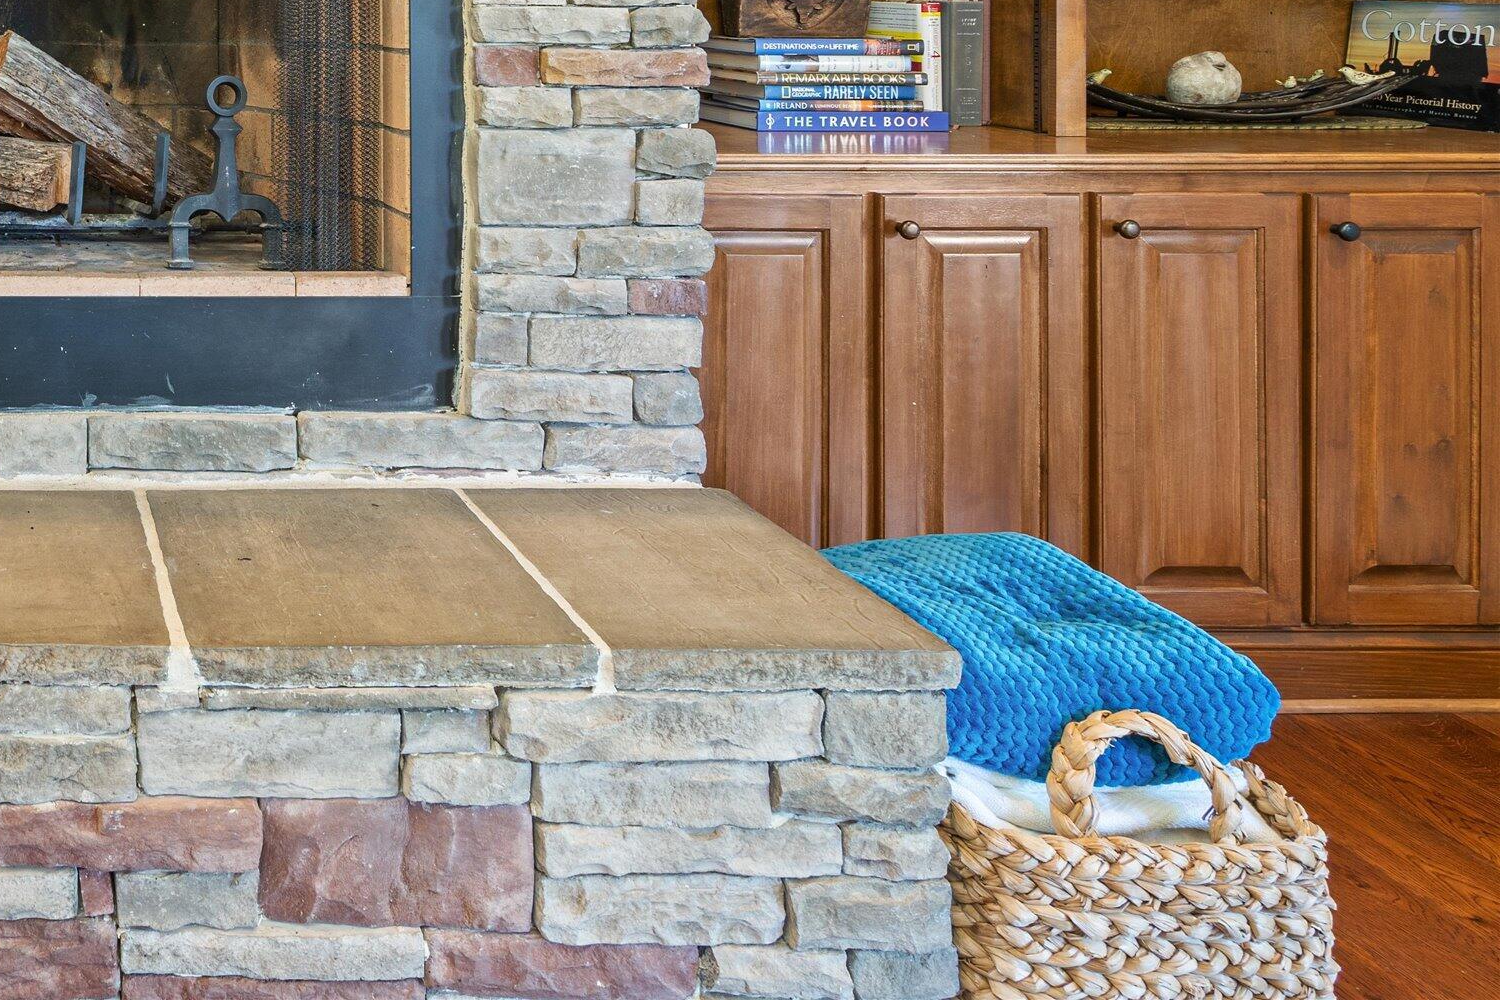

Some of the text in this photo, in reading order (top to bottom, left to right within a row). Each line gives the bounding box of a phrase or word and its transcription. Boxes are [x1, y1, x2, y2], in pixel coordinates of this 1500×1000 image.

[1361, 8, 1496, 47] Cotton
[763, 42, 817, 50] DESTINATIONS
[781, 73, 906, 84] REMARKABLE BOOKS
[824, 86, 899, 100] RARELY SEEN
[773, 102, 807, 110] IRELAND
[1384, 93, 1403, 103] Year
[1406, 95, 1444, 108] Pictorial
[1446, 99, 1482, 113] History
[784, 116, 929, 127] THE TRAVEL BOOK
